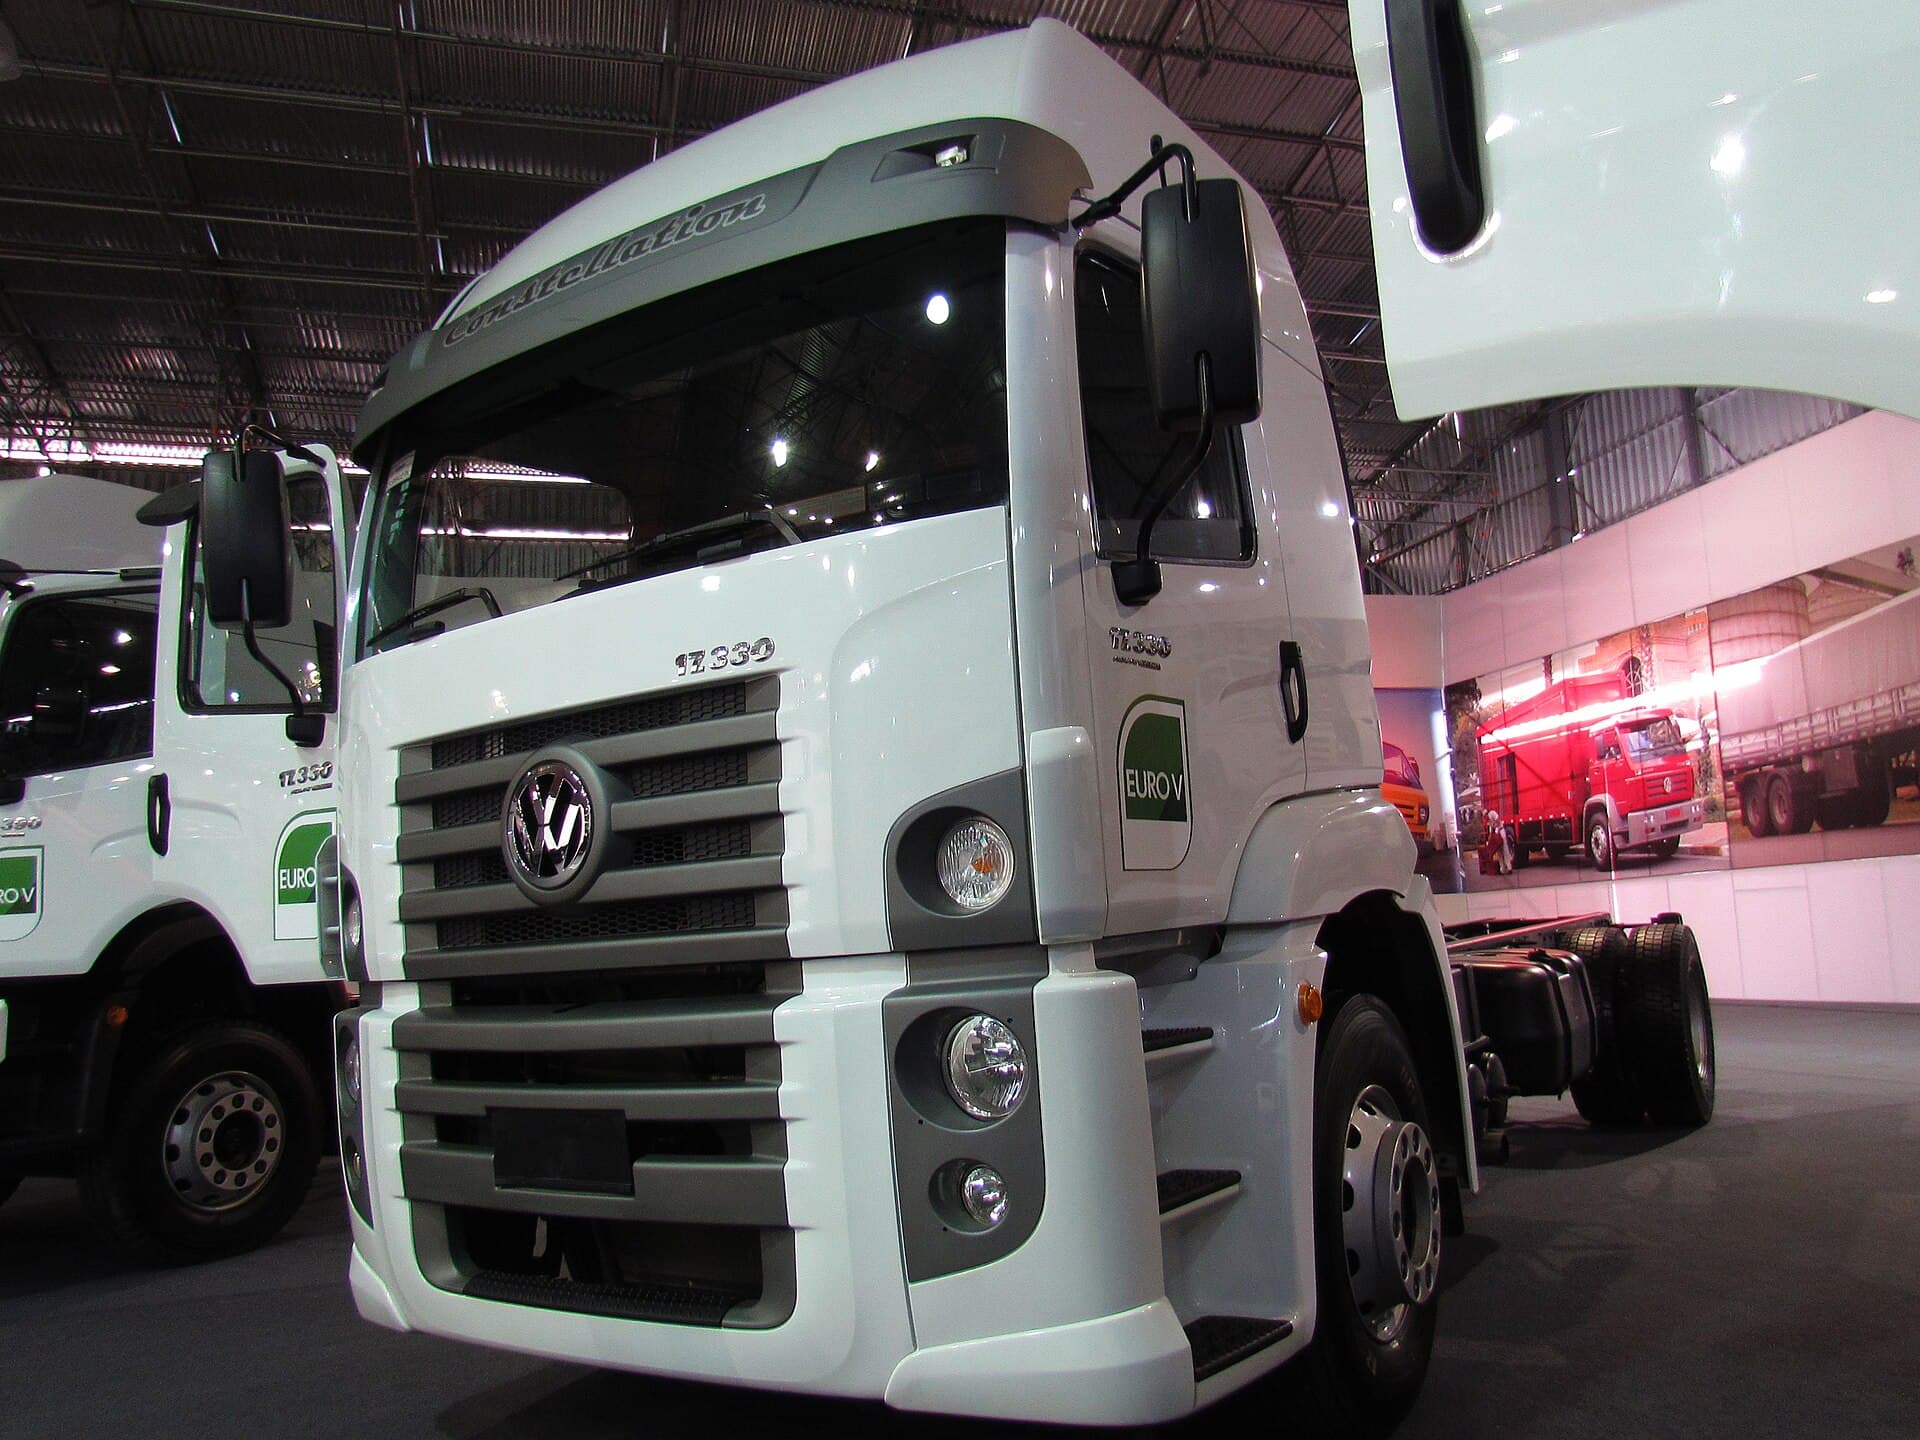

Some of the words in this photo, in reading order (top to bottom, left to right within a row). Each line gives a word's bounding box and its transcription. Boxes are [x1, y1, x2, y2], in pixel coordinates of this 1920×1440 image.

[443, 193, 767, 348] Constellation
[1125, 768, 1170, 801] EURO
[1171, 773, 1183, 801] V
[279, 866, 317, 889] EURO
